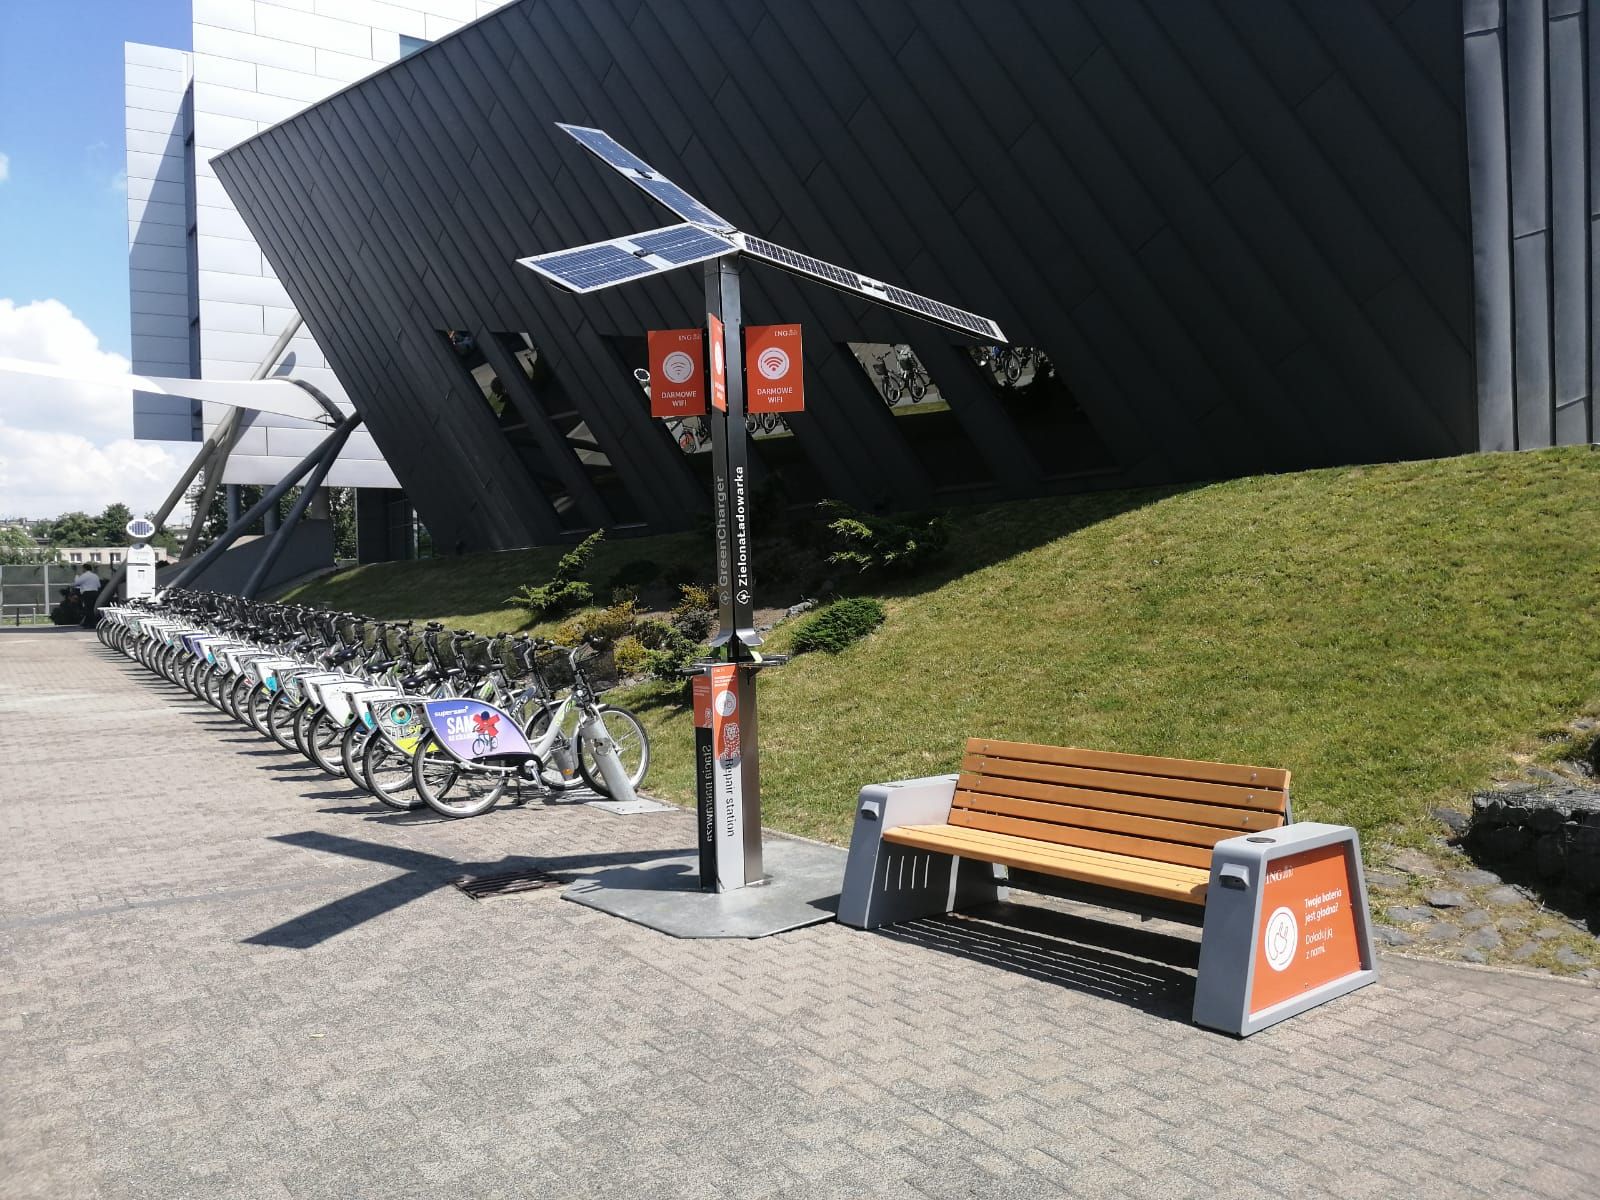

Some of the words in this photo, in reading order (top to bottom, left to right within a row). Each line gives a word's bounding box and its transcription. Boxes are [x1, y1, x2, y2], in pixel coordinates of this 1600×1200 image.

[661, 391, 697, 399] DARMOWE
[756, 387, 793, 396] DARMOWE
[767, 395, 783, 404] WIFI
[672, 399, 687, 407] WIFI
[716, 475, 728, 587] GreenCharger
[734, 466, 748, 587] ZielonaŁadowarka
[723, 758, 735, 794] Repair
[725, 797, 737, 837] station
[1265, 870, 1282, 885] ING
[1304, 895, 1322, 909] Twoja
[1322, 888, 1342, 903] bateria
[1304, 913, 1317, 926] jest
[1316, 902, 1339, 922] głodna?
[1305, 927, 1327, 945] Doładuj
